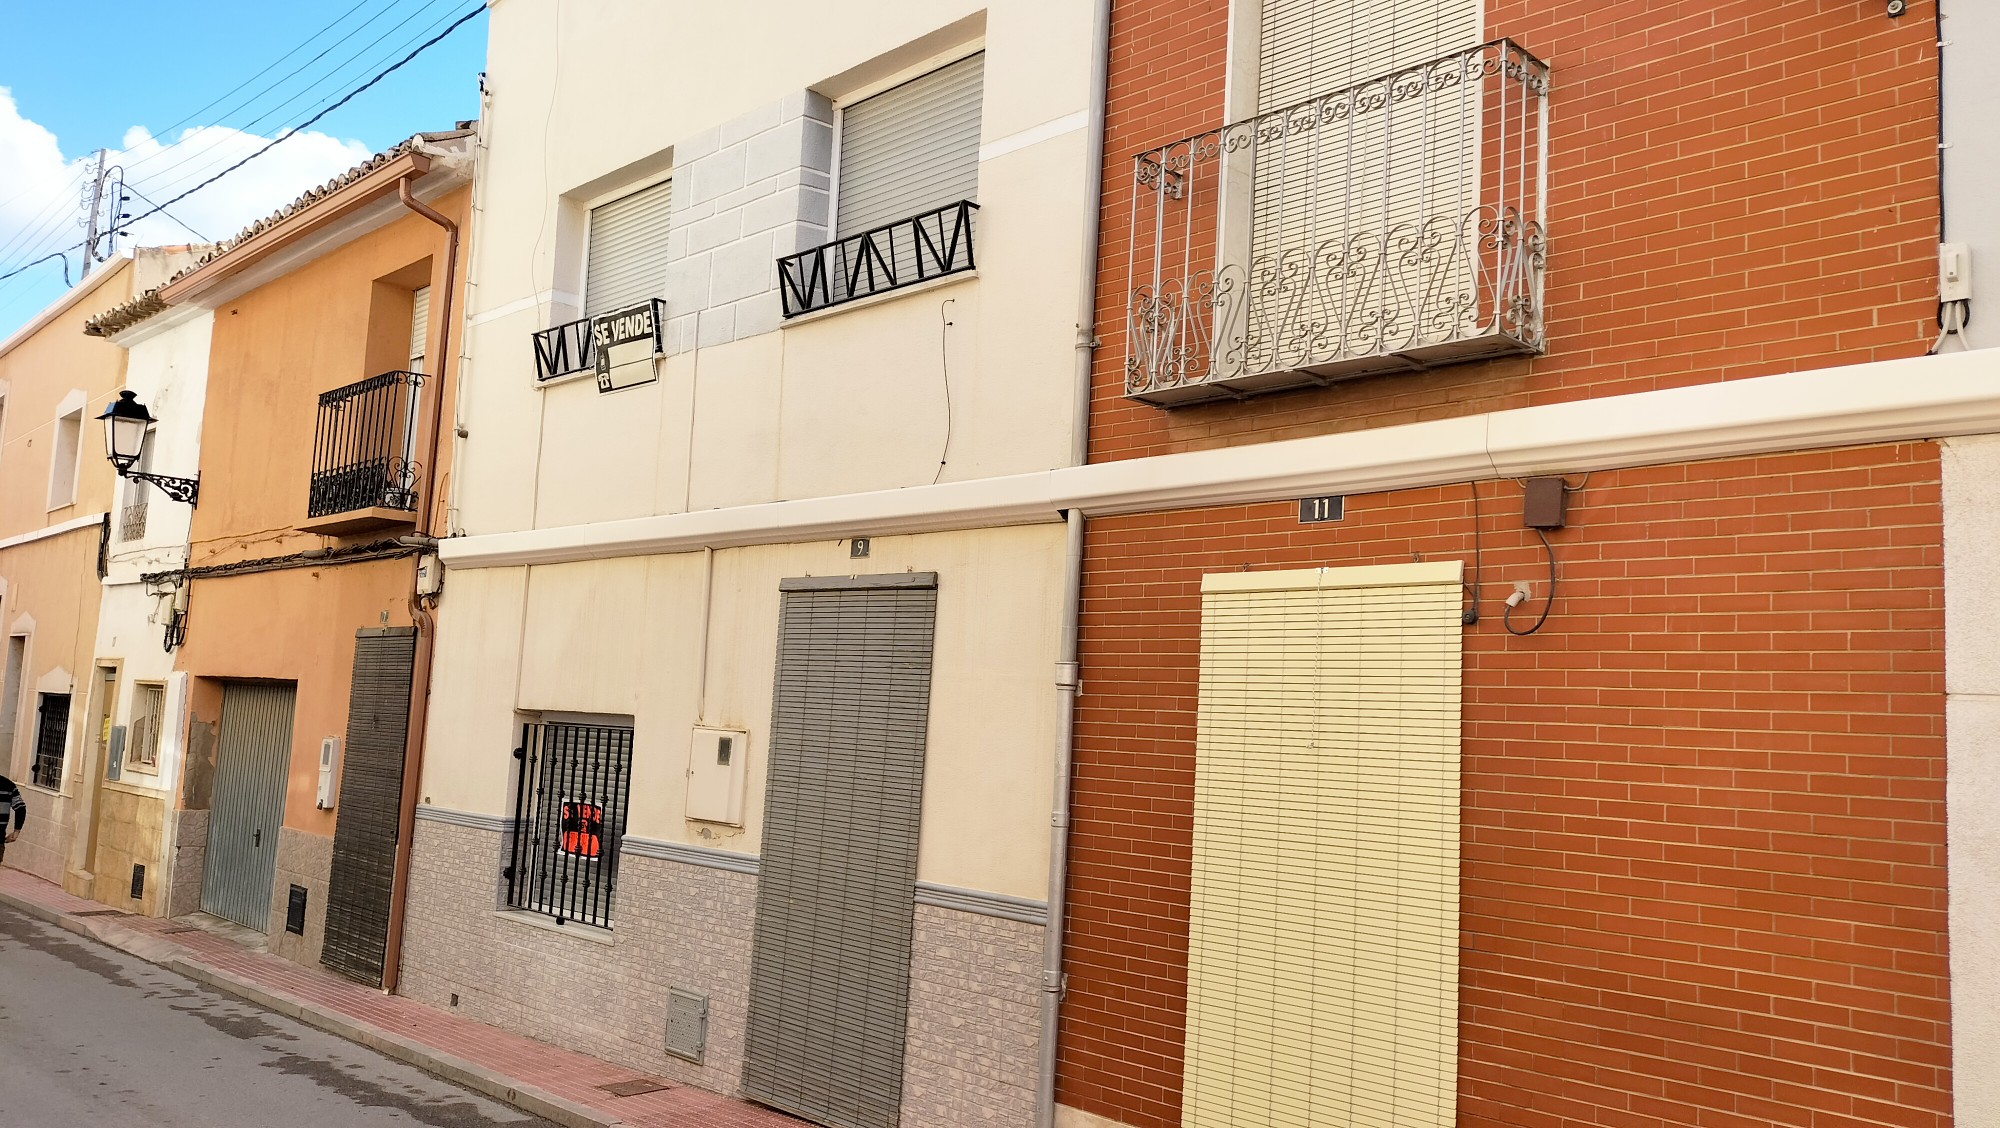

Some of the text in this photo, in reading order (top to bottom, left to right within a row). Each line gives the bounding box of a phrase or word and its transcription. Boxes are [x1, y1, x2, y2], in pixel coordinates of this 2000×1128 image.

[594, 310, 653, 347] SE VENDE
[1313, 498, 1329, 519] 11
[857, 540, 864, 556] 9
